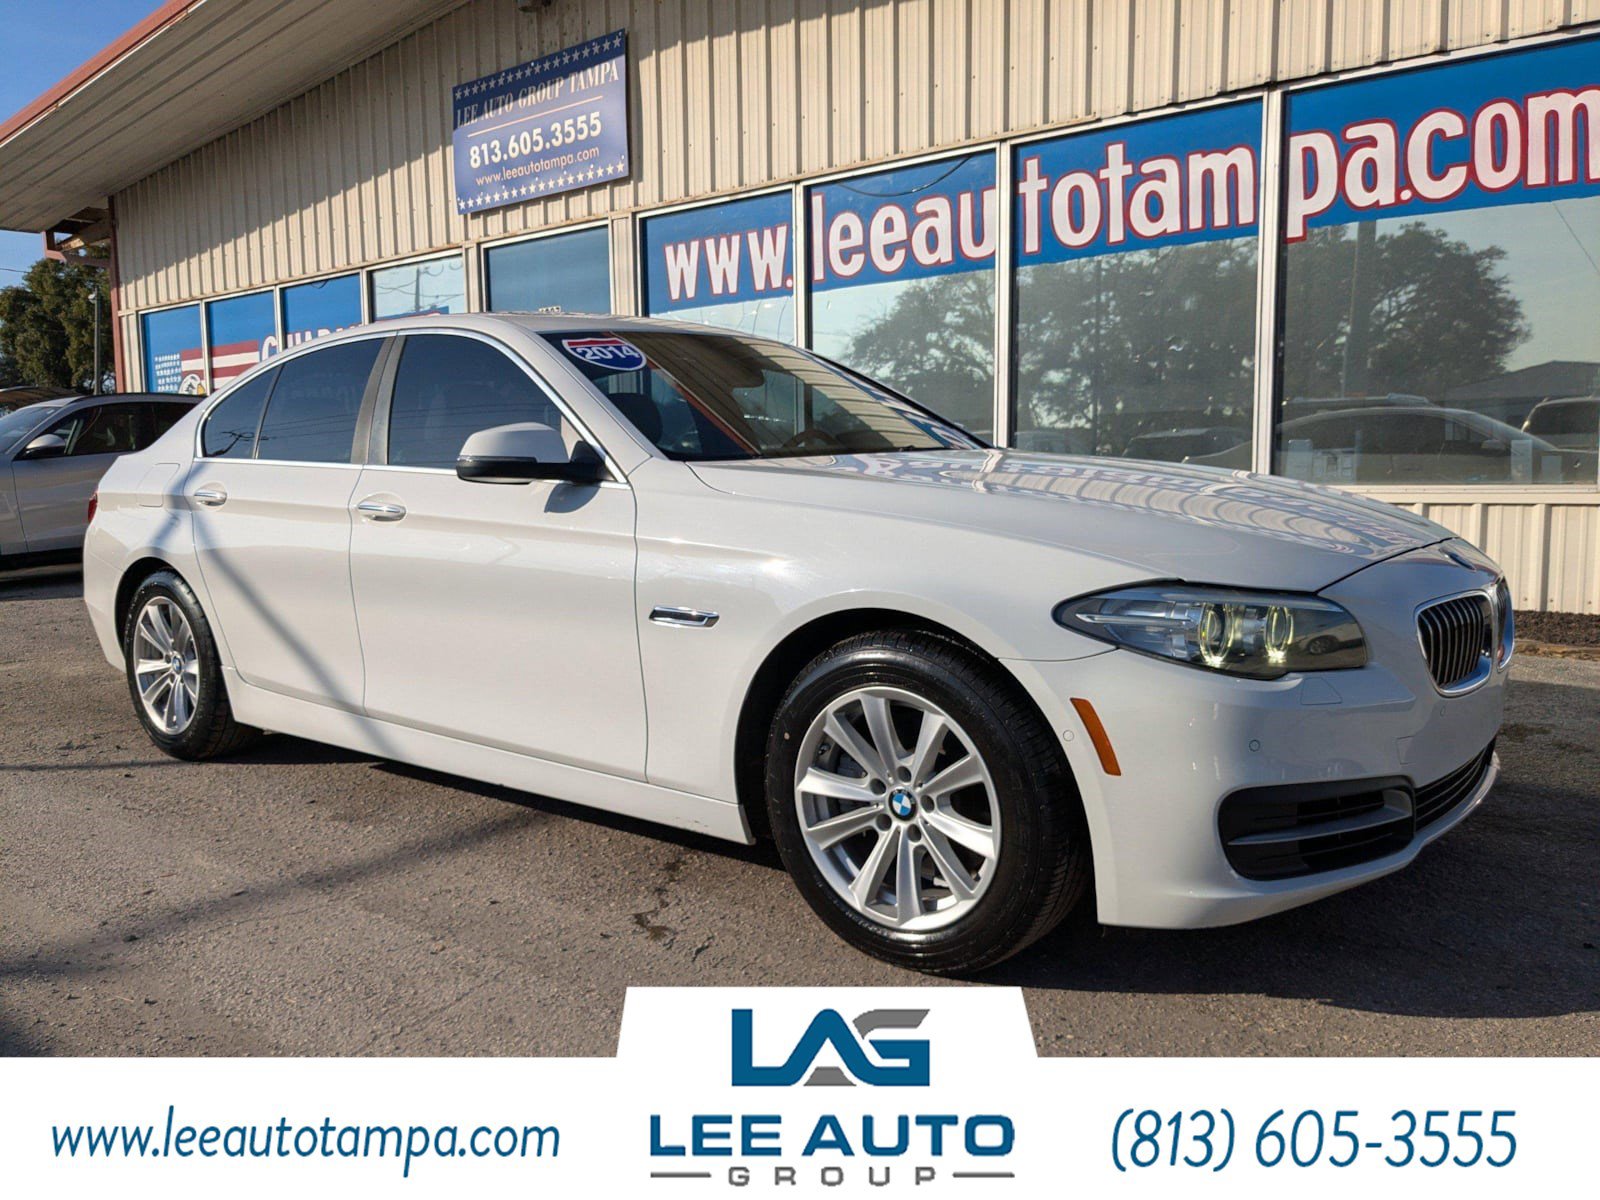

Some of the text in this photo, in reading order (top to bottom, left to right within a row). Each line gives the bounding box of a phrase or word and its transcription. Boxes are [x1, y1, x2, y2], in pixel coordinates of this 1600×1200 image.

[457, 60, 619, 129] LEE AUTO GROUP TAMPA
[469, 111, 602, 169] 813.605.3555
[475, 146, 600, 187] www.leeautotampa.com
[577, 345, 641, 360] 2014
